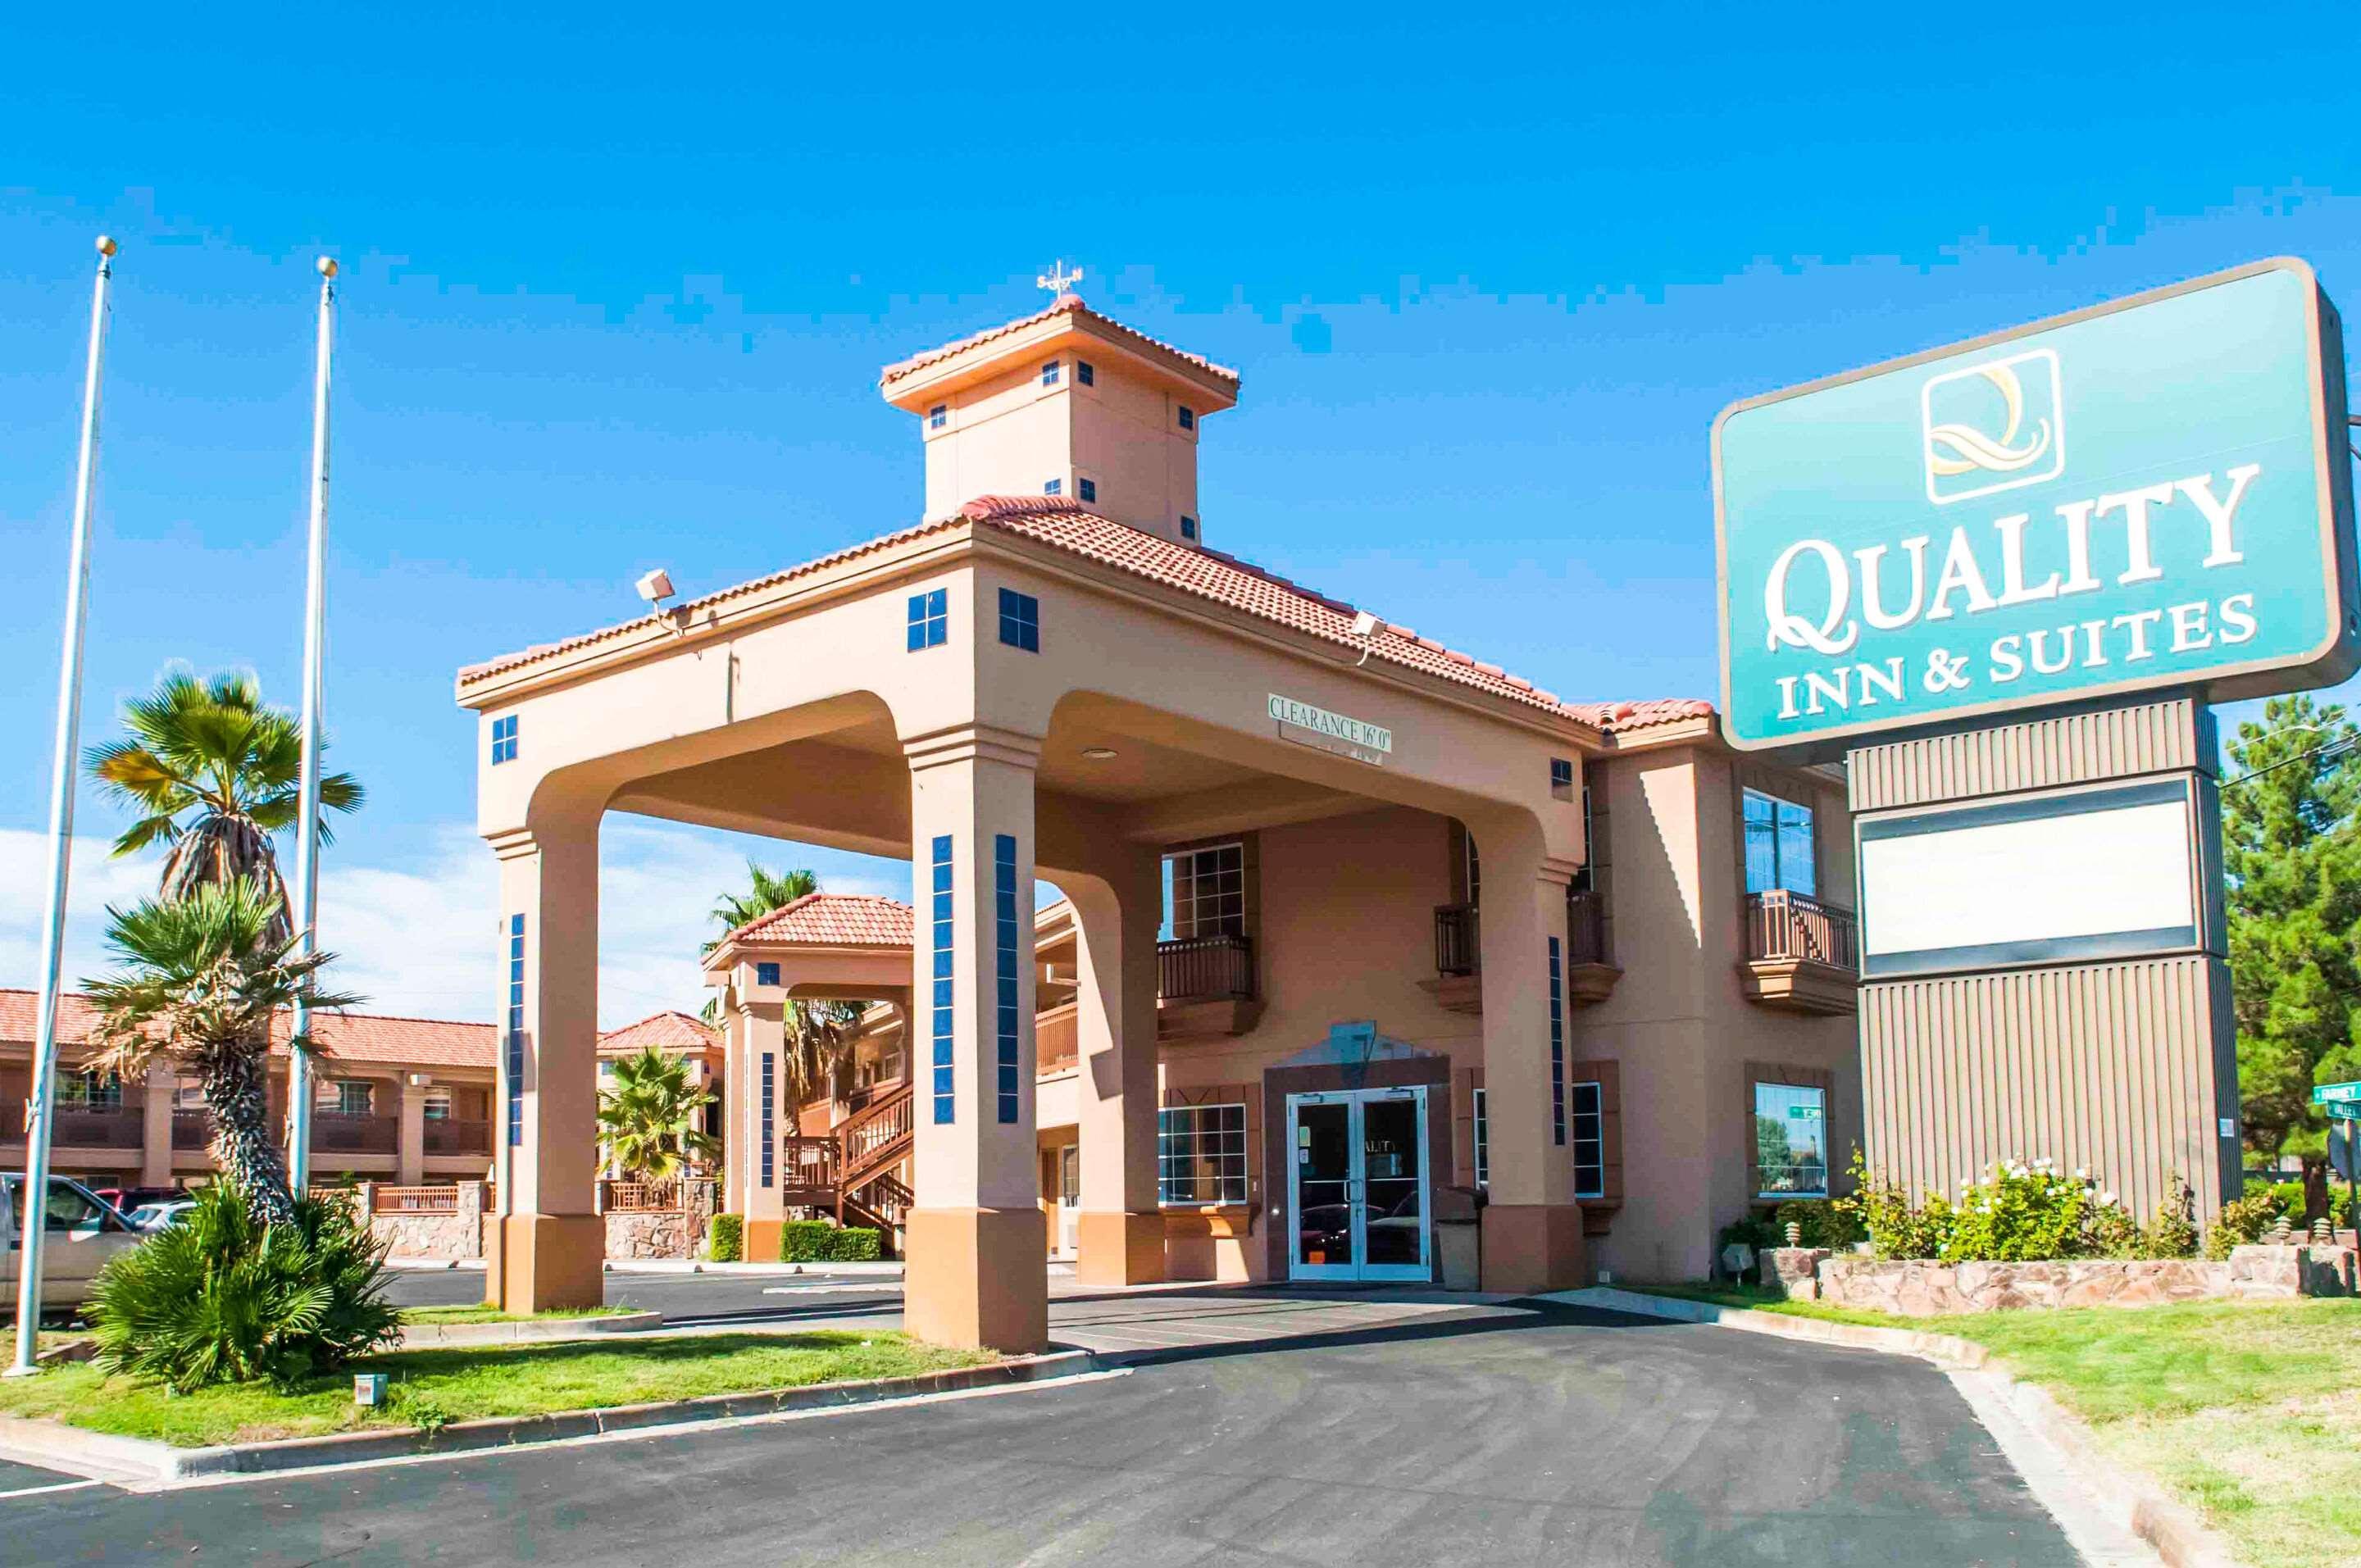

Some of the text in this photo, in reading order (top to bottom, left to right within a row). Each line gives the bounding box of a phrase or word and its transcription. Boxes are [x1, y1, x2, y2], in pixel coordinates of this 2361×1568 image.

[1765, 464, 2261, 655] QUALITY
[1270, 697, 1358, 742] CLEARANCE
[1776, 593, 2259, 720] INN & SUITES
